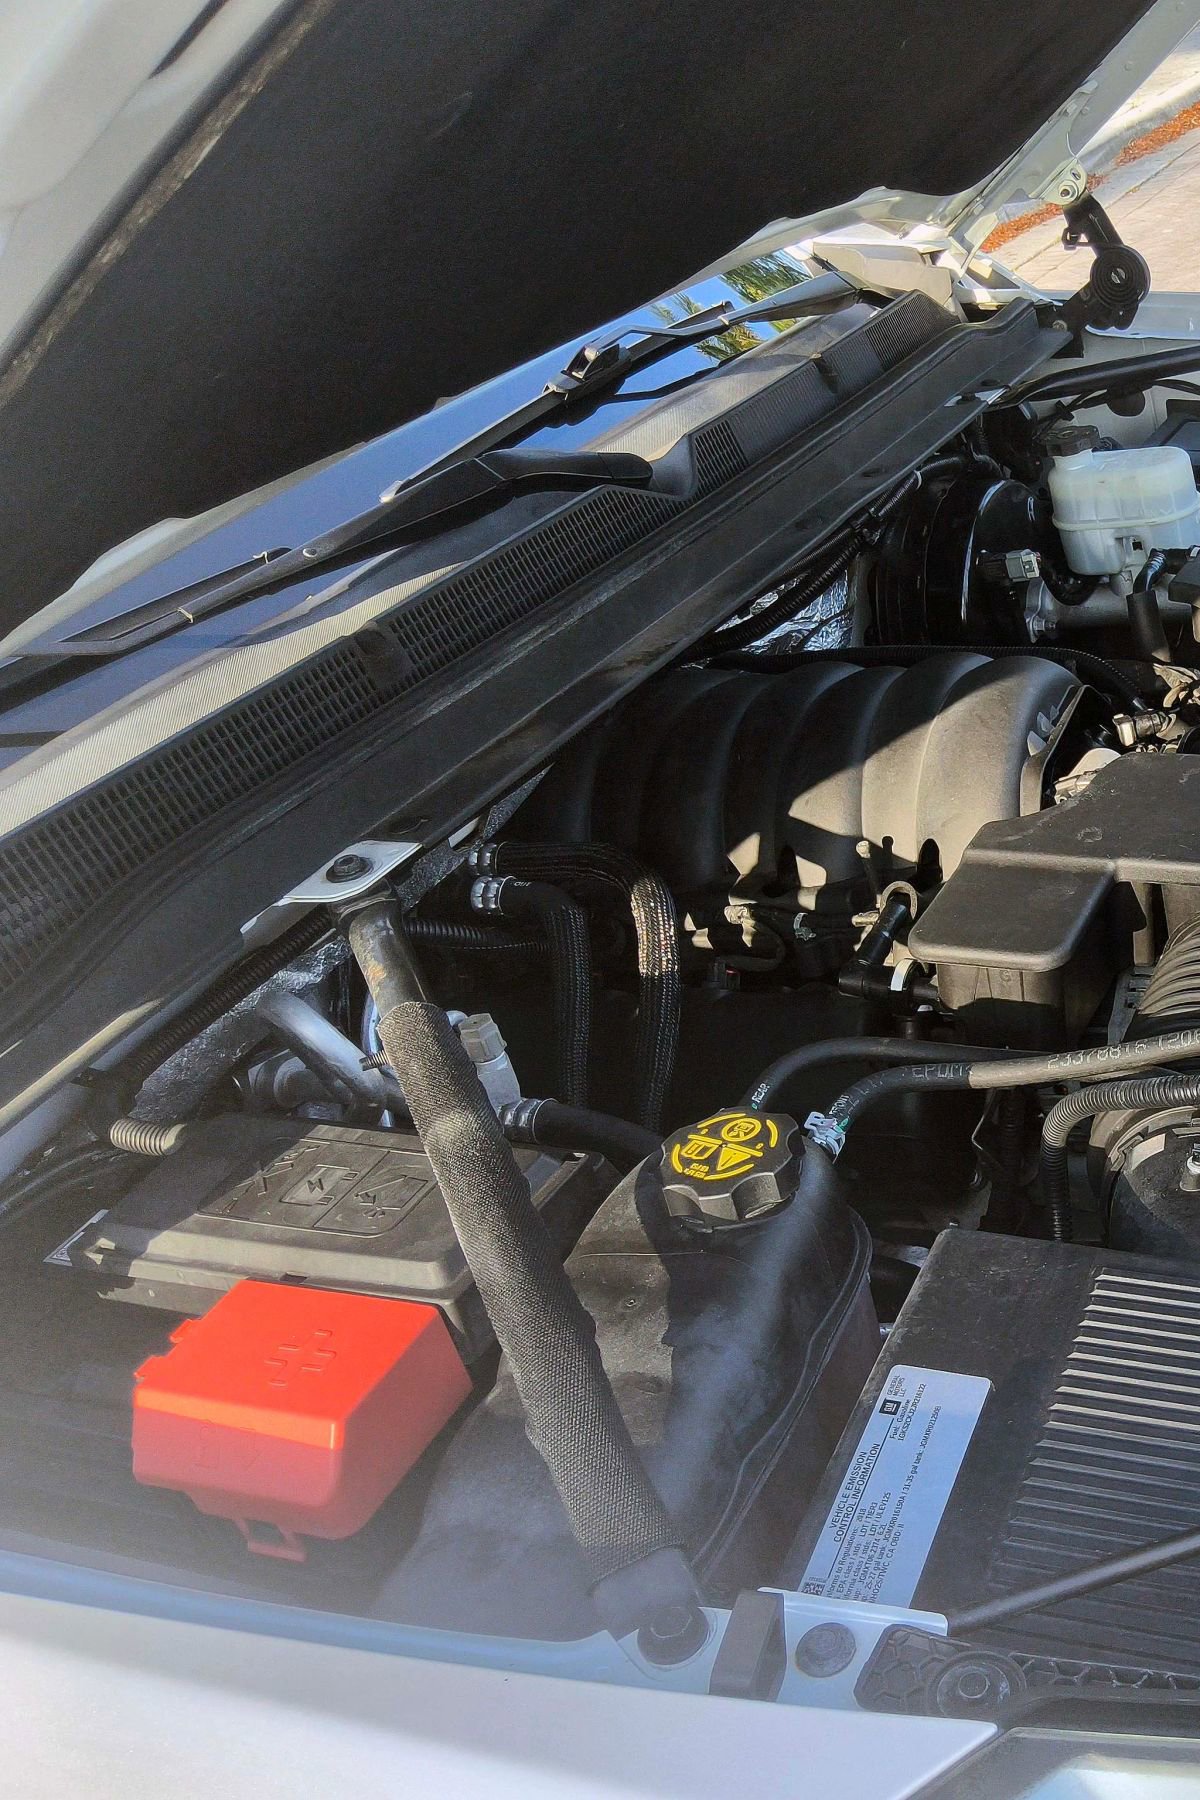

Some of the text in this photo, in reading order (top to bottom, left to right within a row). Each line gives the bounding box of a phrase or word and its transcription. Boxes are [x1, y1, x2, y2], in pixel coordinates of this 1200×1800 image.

[751, 1082, 771, 1104] REAR
[886, 1375, 899, 1395] GENERAL
[892, 1377, 904, 1395] MOTORS
[897, 1387, 906, 1397] LLC
[889, 1399, 911, 1439] Fuel: Gasoline
[829, 1451, 867, 1528] VEHICLE EMISSION
[833, 1443, 879, 1542] CONTROL INFORMATION
[837, 1526, 859, 1565] Regulations:
[855, 1508, 866, 1522] 2018
[853, 1560, 863, 1576] class
[867, 1523, 878, 1536] LDT
[875, 1492, 891, 1518] ULEV125
[864, 1571, 876, 1589] 25-27
[872, 1560, 881, 1571] gal
[902, 1475, 914, 1491] 31-35
[910, 1464, 918, 1474] gal
[876, 1523, 887, 1535] 6.2L
[835, 1579, 847, 1593] EPA
[843, 1561, 854, 1578] class
[858, 1524, 869, 1537] LDT
[865, 1501, 878, 1518] TIER3
[885, 1548, 895, 1558] CA
